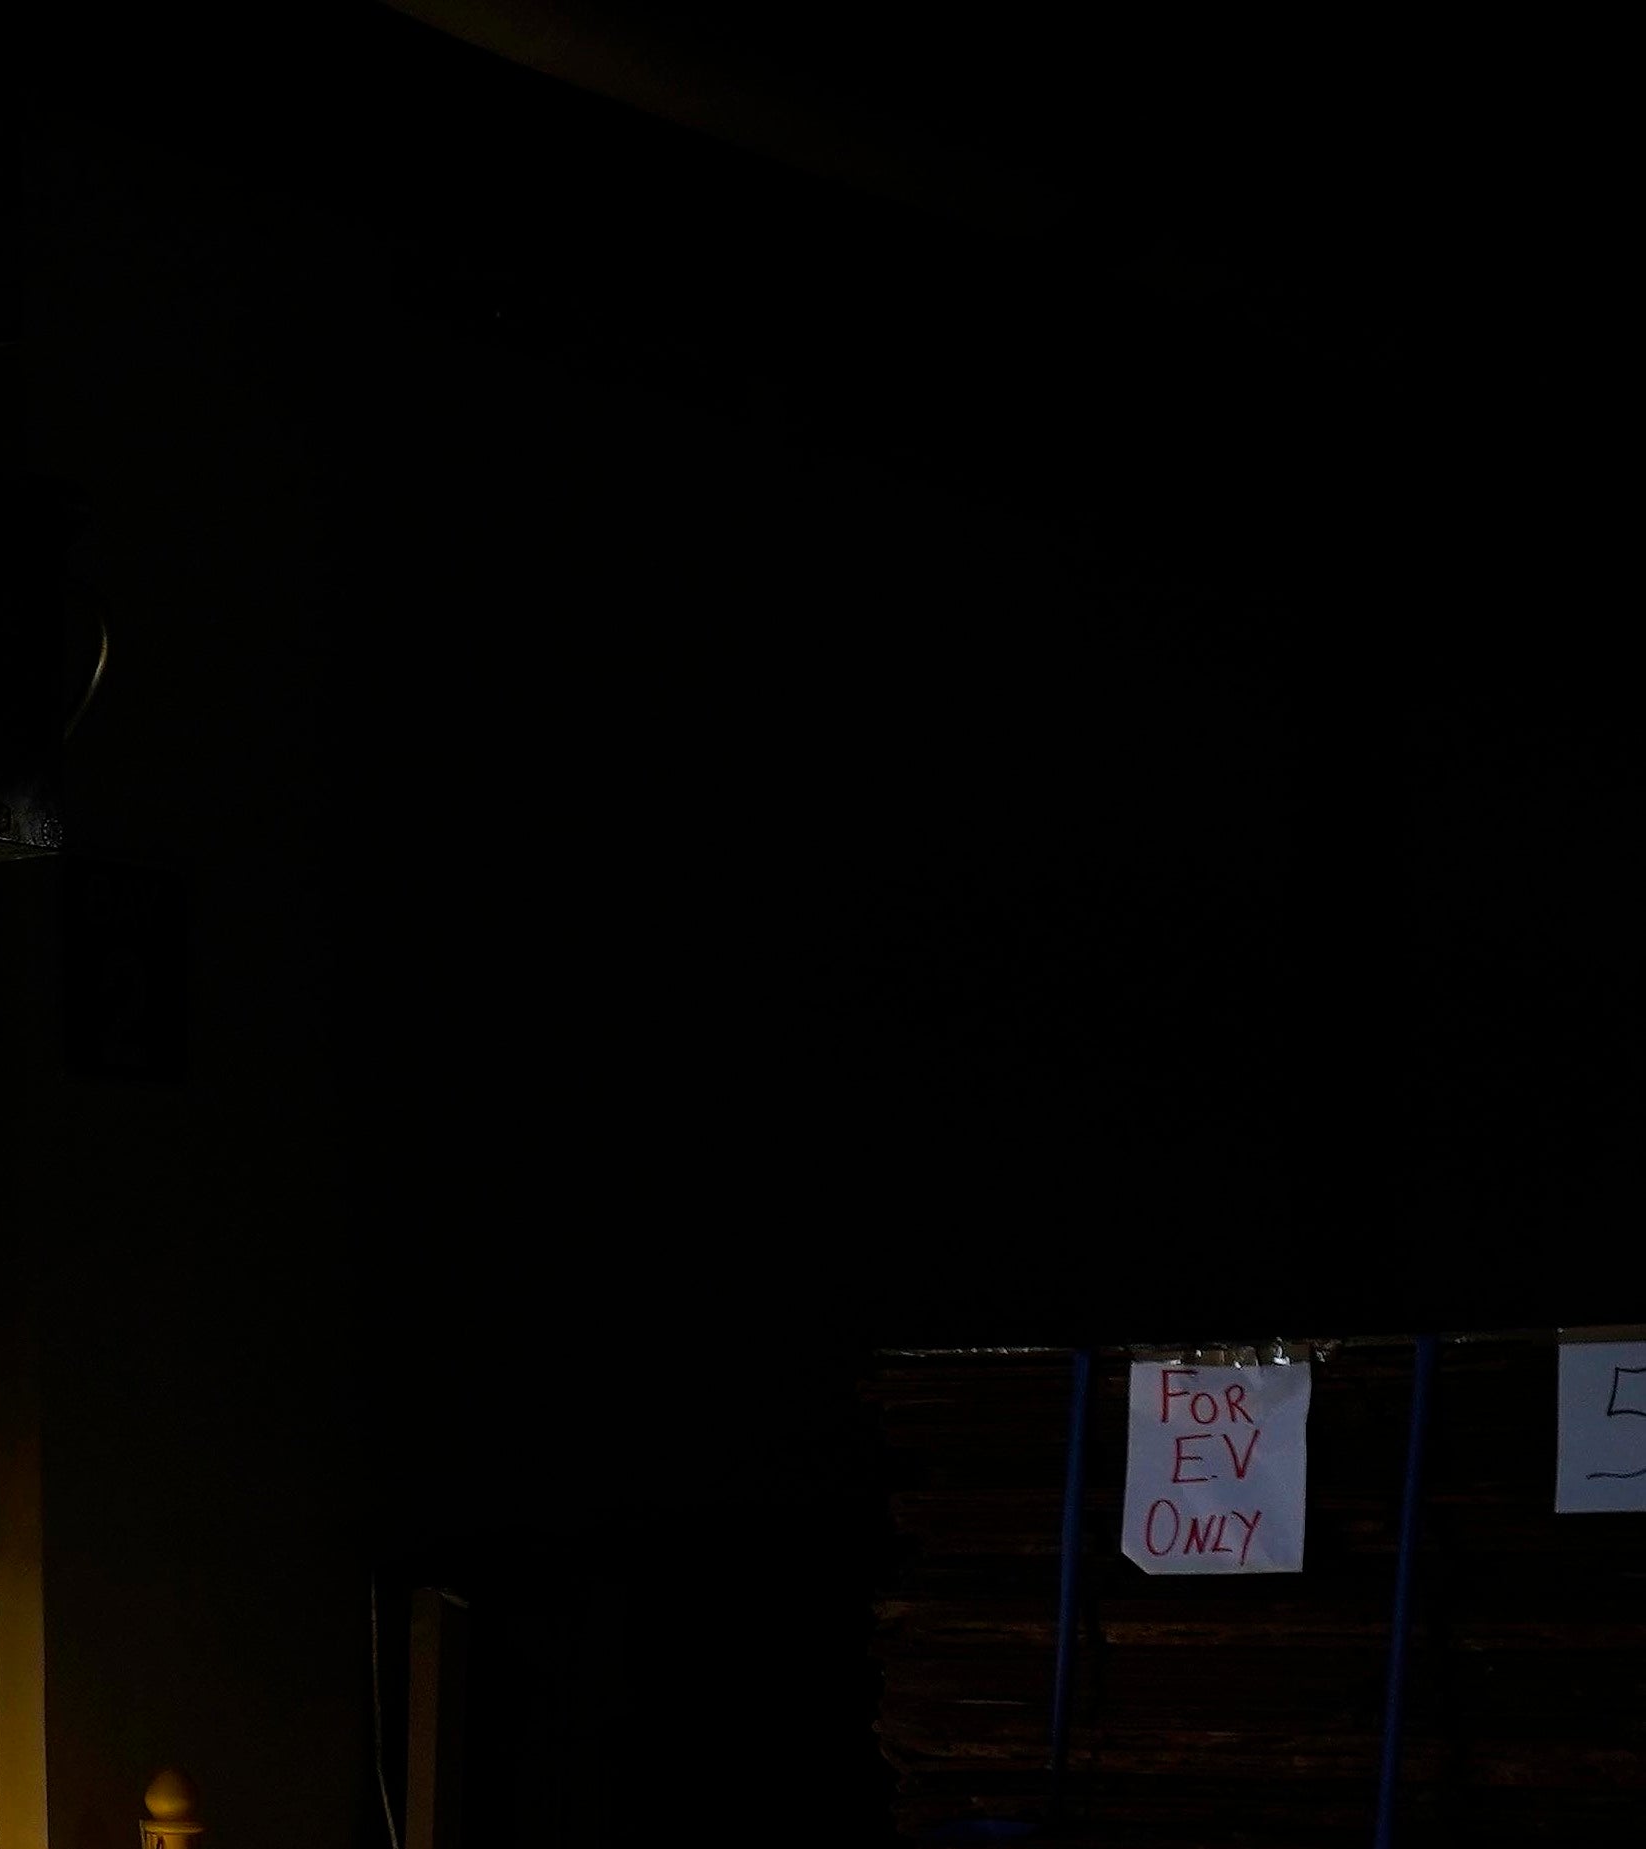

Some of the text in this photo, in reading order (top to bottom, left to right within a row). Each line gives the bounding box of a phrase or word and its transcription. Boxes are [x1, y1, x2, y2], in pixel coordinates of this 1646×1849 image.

[1161, 1368, 1255, 1425] FOR
[1172, 1429, 1261, 1484] EV
[1145, 1499, 1262, 1567] ONLY
